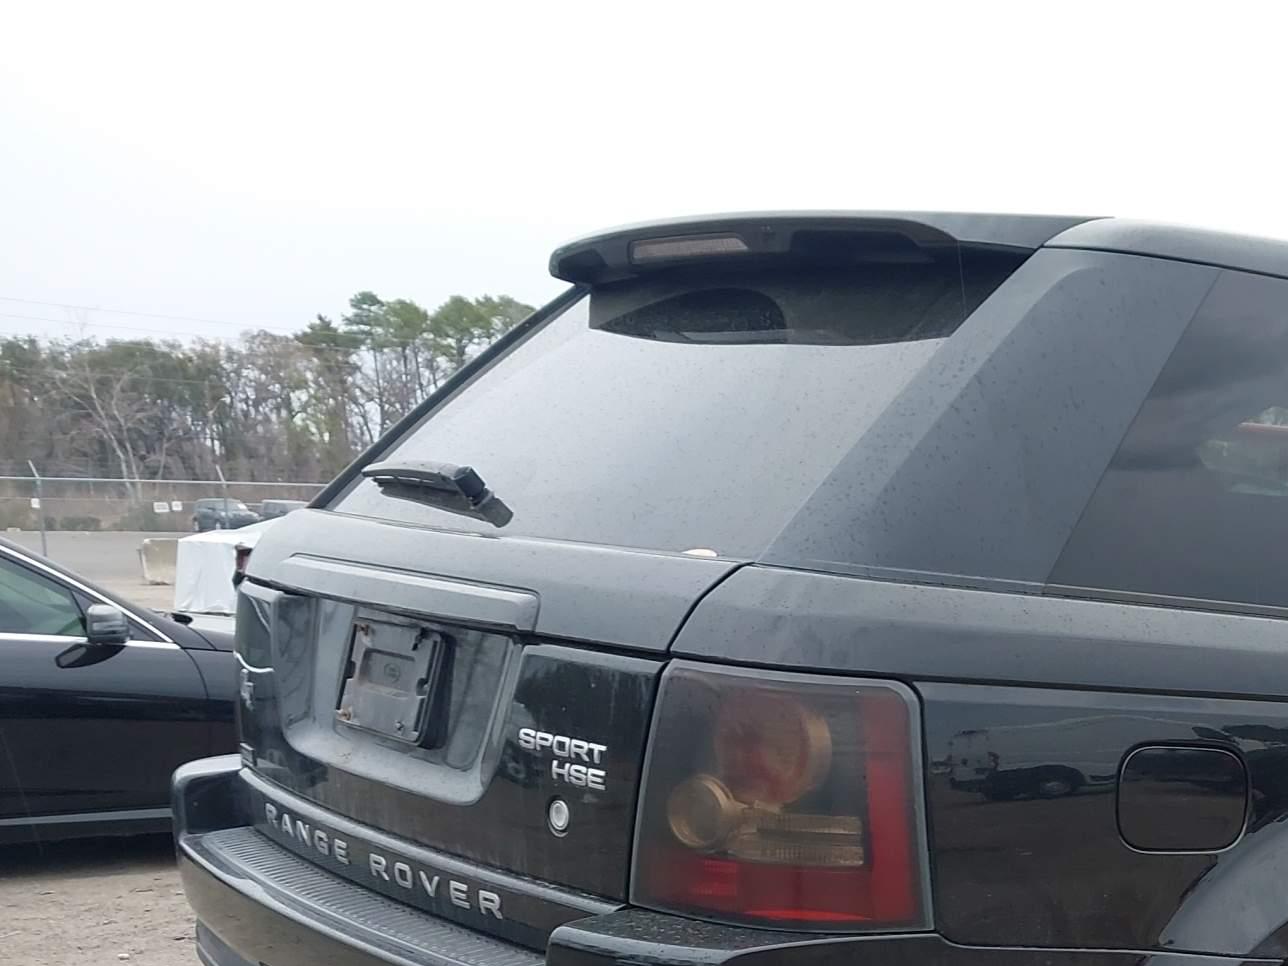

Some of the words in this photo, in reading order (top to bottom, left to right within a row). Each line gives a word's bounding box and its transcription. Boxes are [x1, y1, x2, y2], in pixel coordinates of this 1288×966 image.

[518, 727, 608, 764] SPORT
[551, 759, 606, 791] HSE
[265, 802, 350, 865] RANGE
[368, 852, 504, 920] ROVER
